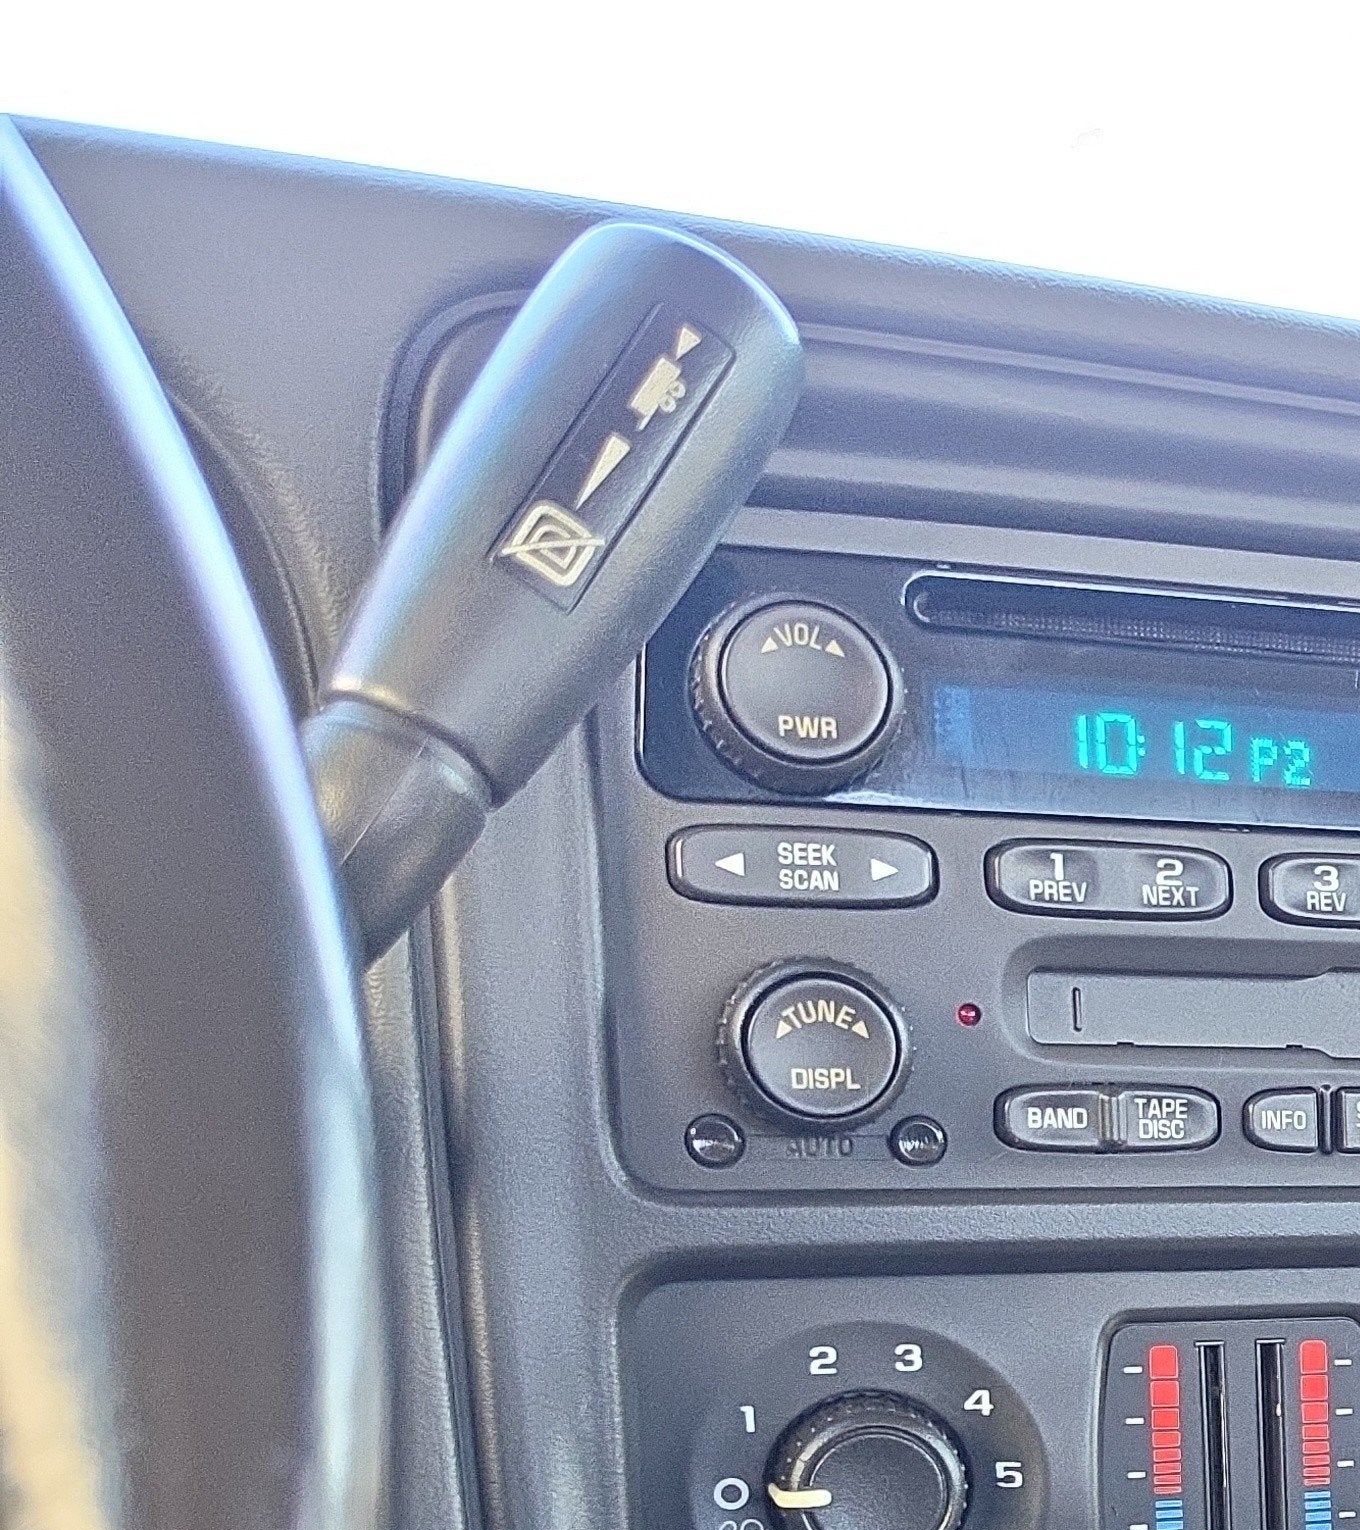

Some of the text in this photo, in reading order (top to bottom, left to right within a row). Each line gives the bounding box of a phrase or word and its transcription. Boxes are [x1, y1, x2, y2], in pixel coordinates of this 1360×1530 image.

[774, 623, 823, 650] VOL
[778, 716, 838, 739] PWR
[1077, 712, 1310, 787] 10:12 P2
[777, 843, 836, 867] SEEK
[1050, 853, 1065, 881] 1
[779, 869, 839, 892] SCAN
[1156, 858, 1183, 887] 2
[1313, 866, 1339, 891] 3
[1029, 880, 1087, 902] PREV
[1142, 885, 1199, 907] NEXT
[1306, 891, 1346, 912] REV
[782, 1000, 856, 1030] TUNE
[791, 1068, 861, 1090] DISPL
[1027, 1107, 1088, 1129] BAND
[1134, 1099, 1188, 1119] TAPE
[1261, 1110, 1307, 1130] INFO
[1139, 1119, 1185, 1139] DISC
[809, 1345, 838, 1375] 2
[894, 1344, 923, 1372] 3
[963, 1389, 994, 1416] 4
[739, 1406, 756, 1433] 1
[995, 1461, 1024, 1488] 5
